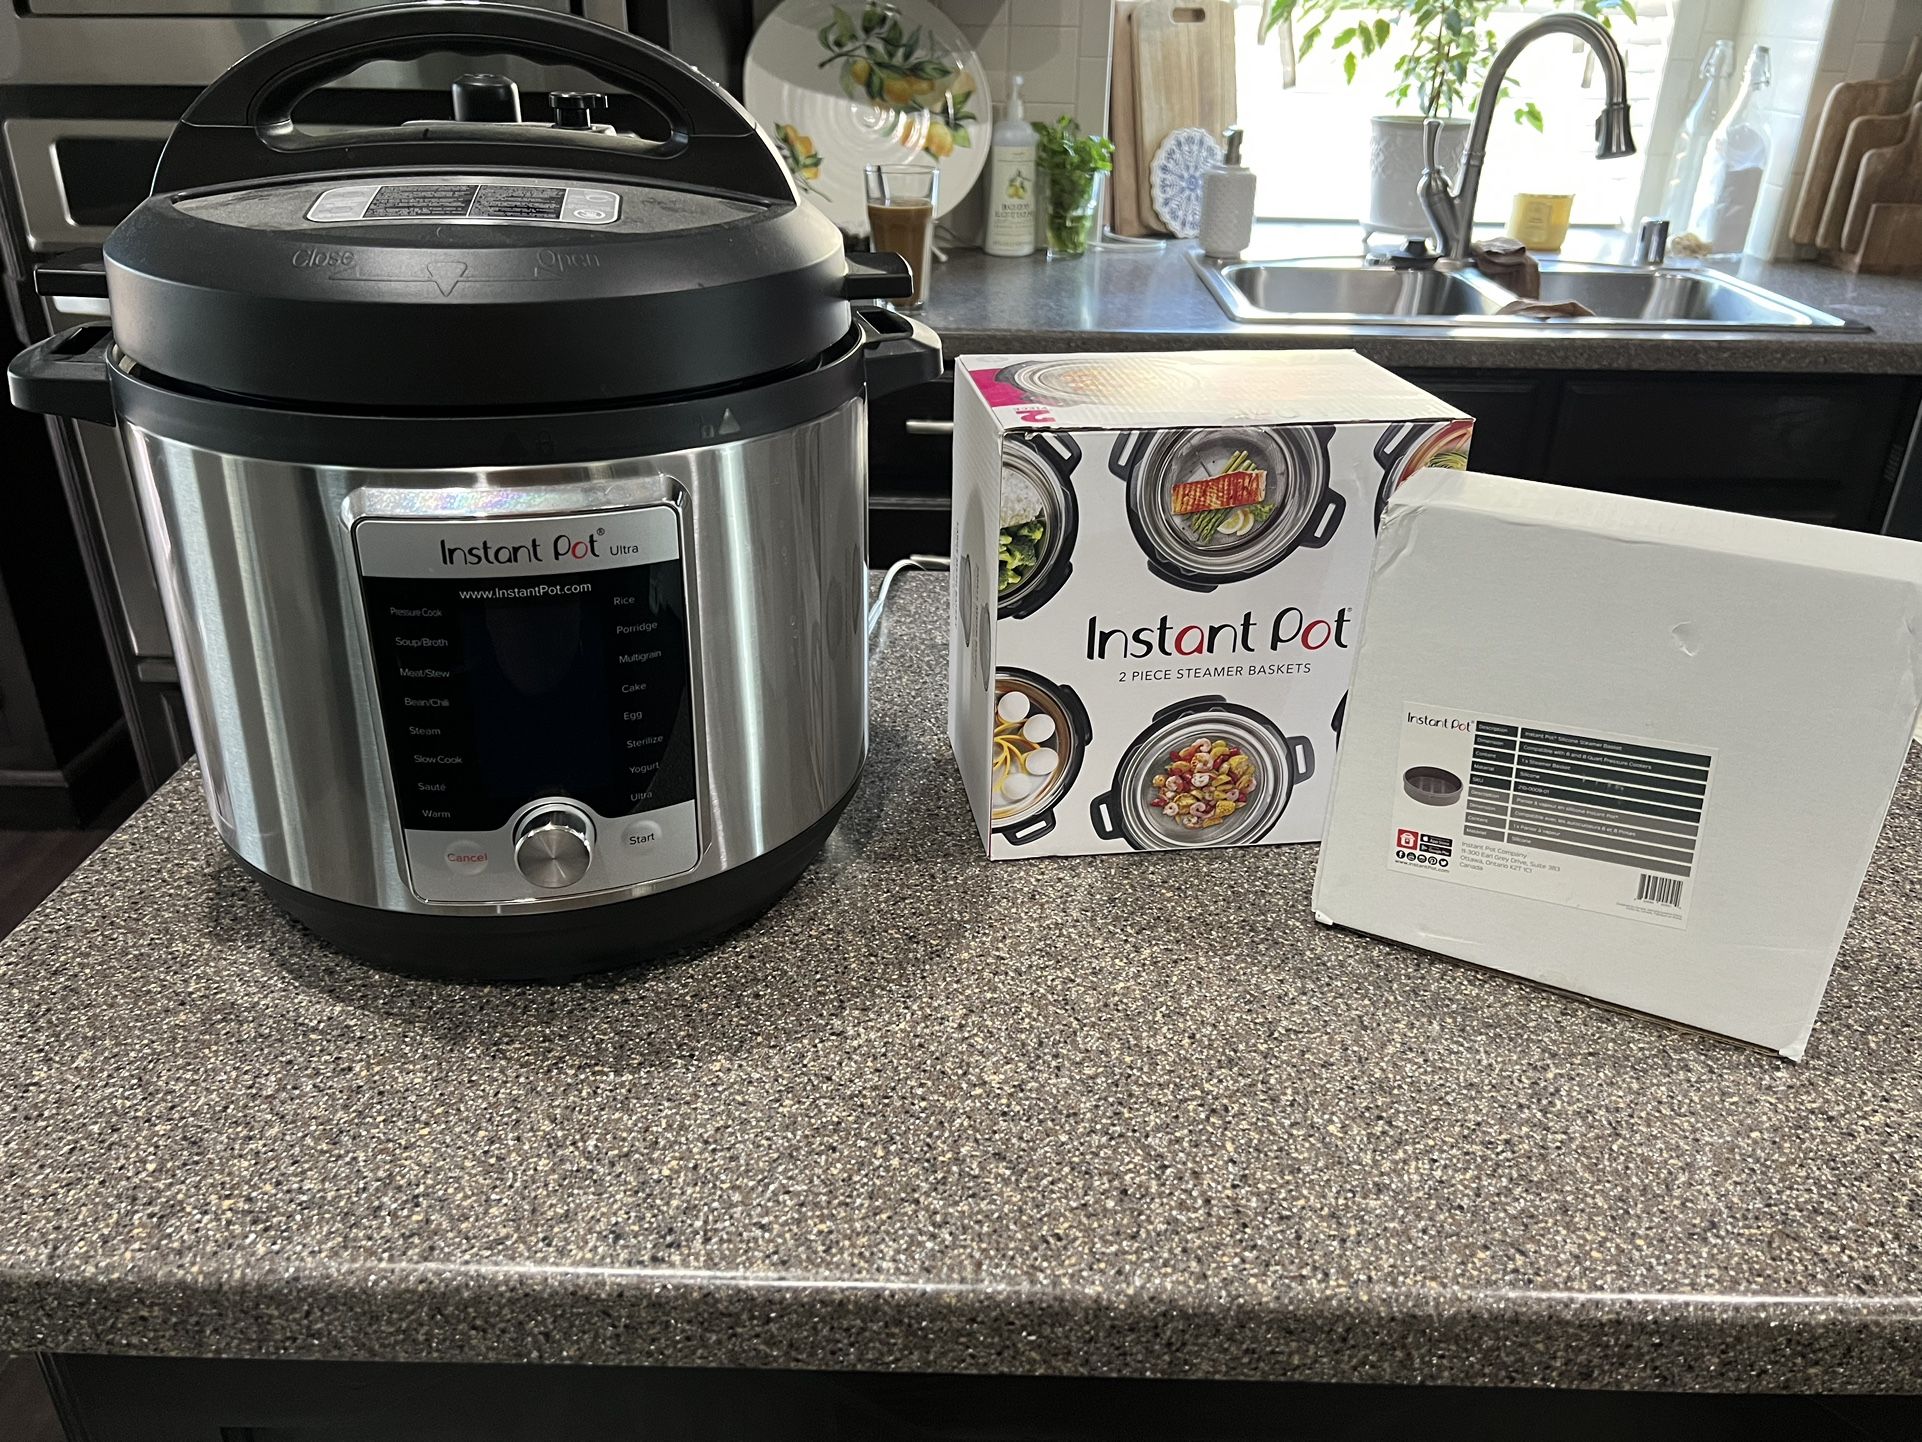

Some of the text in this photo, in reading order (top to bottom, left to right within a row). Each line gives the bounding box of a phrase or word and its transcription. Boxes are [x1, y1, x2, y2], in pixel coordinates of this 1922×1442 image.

[292, 246, 356, 269] Close
[536, 248, 602, 273] Open
[440, 534, 640, 566] Instant Pot Ultra
[459, 582, 592, 600] www.InstantPot.com
[613, 596, 636, 606] Rice
[390, 606, 442, 617] Pressure Cook
[616, 622, 658, 634] Porridge
[1086, 606, 1351, 660] Instant Pot
[395, 636, 449, 648] Soup/Broth
[619, 650, 662, 664] Multigrain
[400, 668, 450, 678] Meat/Stew
[1118, 662, 1312, 682] 2 PIECE STEAMER BASKETS
[622, 683, 646, 693] Cake
[623, 711, 643, 721] Egg
[1407, 712, 1470, 732] Instant Pot
[408, 726, 442, 736] Steam
[626, 736, 664, 748] Sterilize
[414, 754, 464, 764] Slow Cook
[629, 762, 660, 774] Yogurt
[630, 791, 653, 802] Ultra
[422, 810, 451, 818] Warm
[629, 832, 655, 846] Start
[447, 852, 488, 862] Cancel
